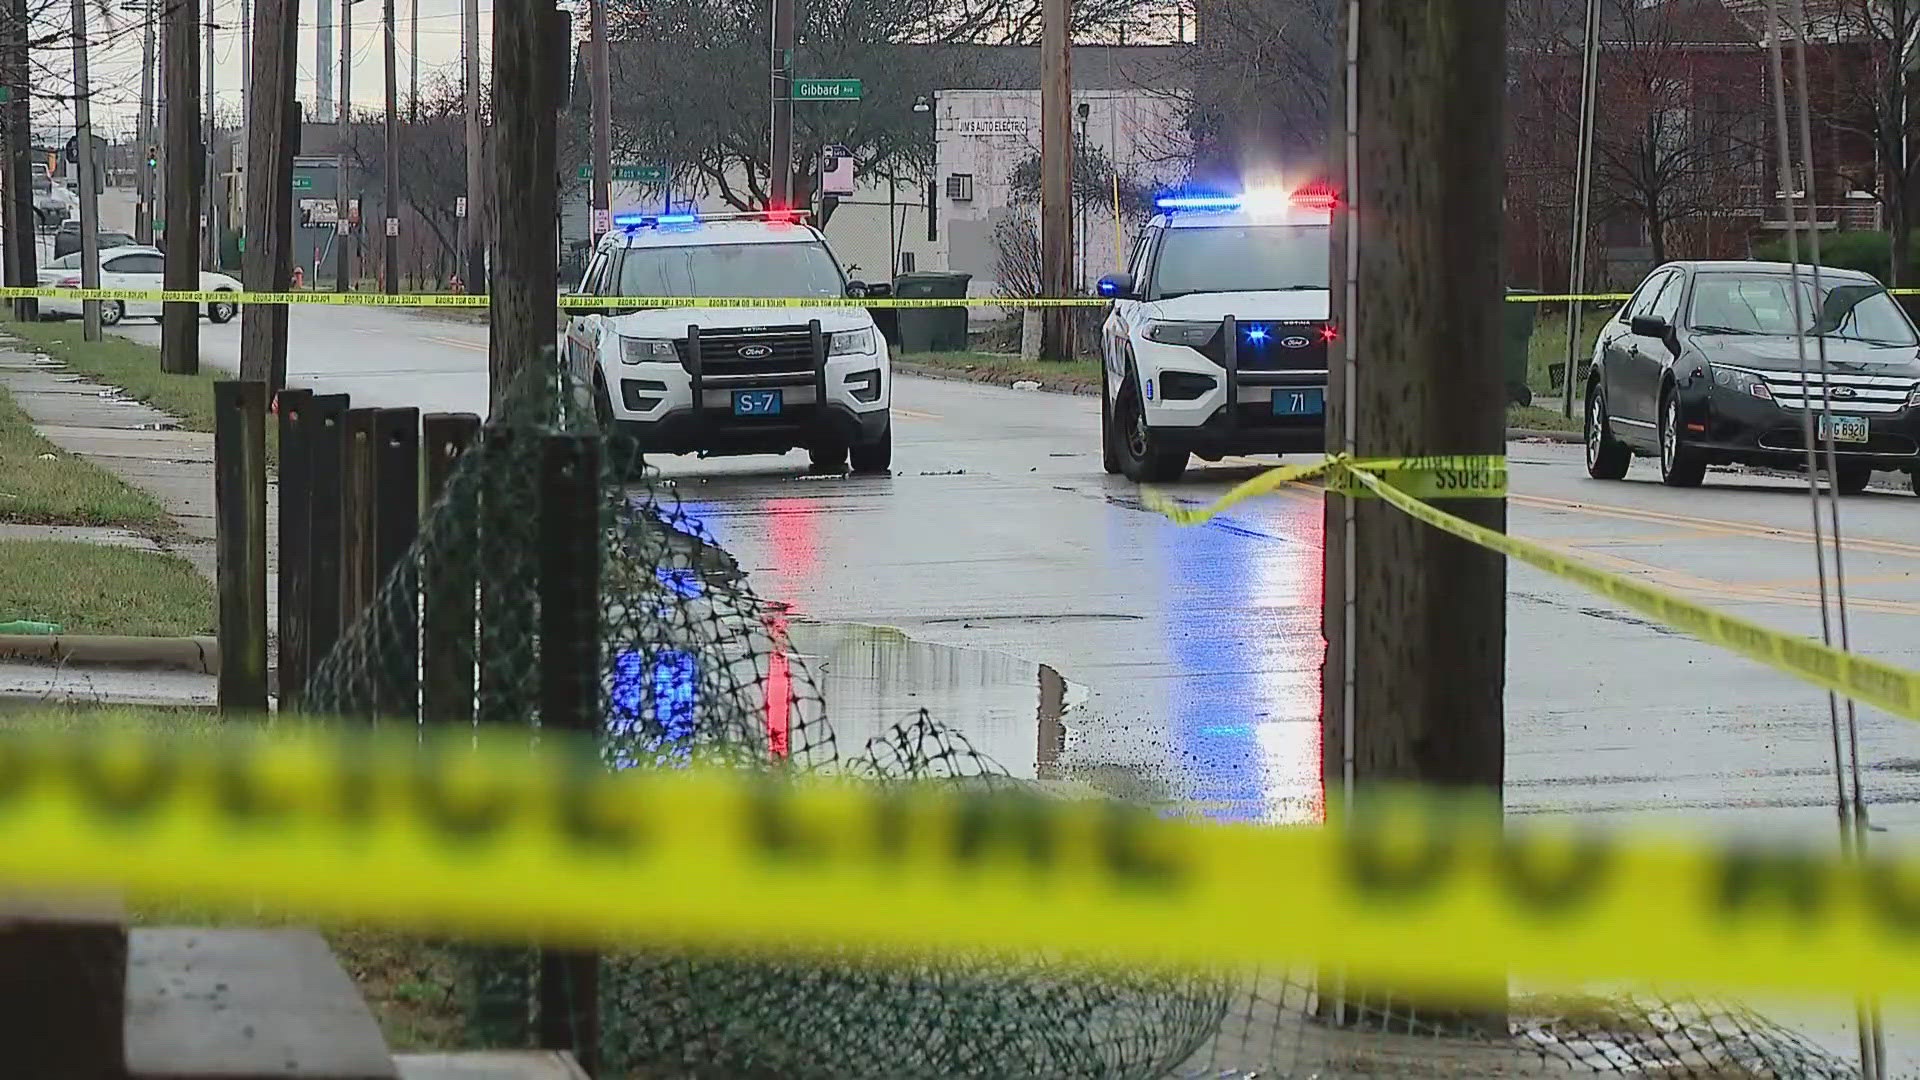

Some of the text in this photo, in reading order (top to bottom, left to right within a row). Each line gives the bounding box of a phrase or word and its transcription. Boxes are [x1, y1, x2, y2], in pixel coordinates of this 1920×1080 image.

[800, 83, 840, 96] Gibbard
[976, 121, 994, 132] AUTO
[740, 394, 774, 412] S-7
[1290, 393, 1304, 412] 71
[1842, 422, 1866, 437] 8920
